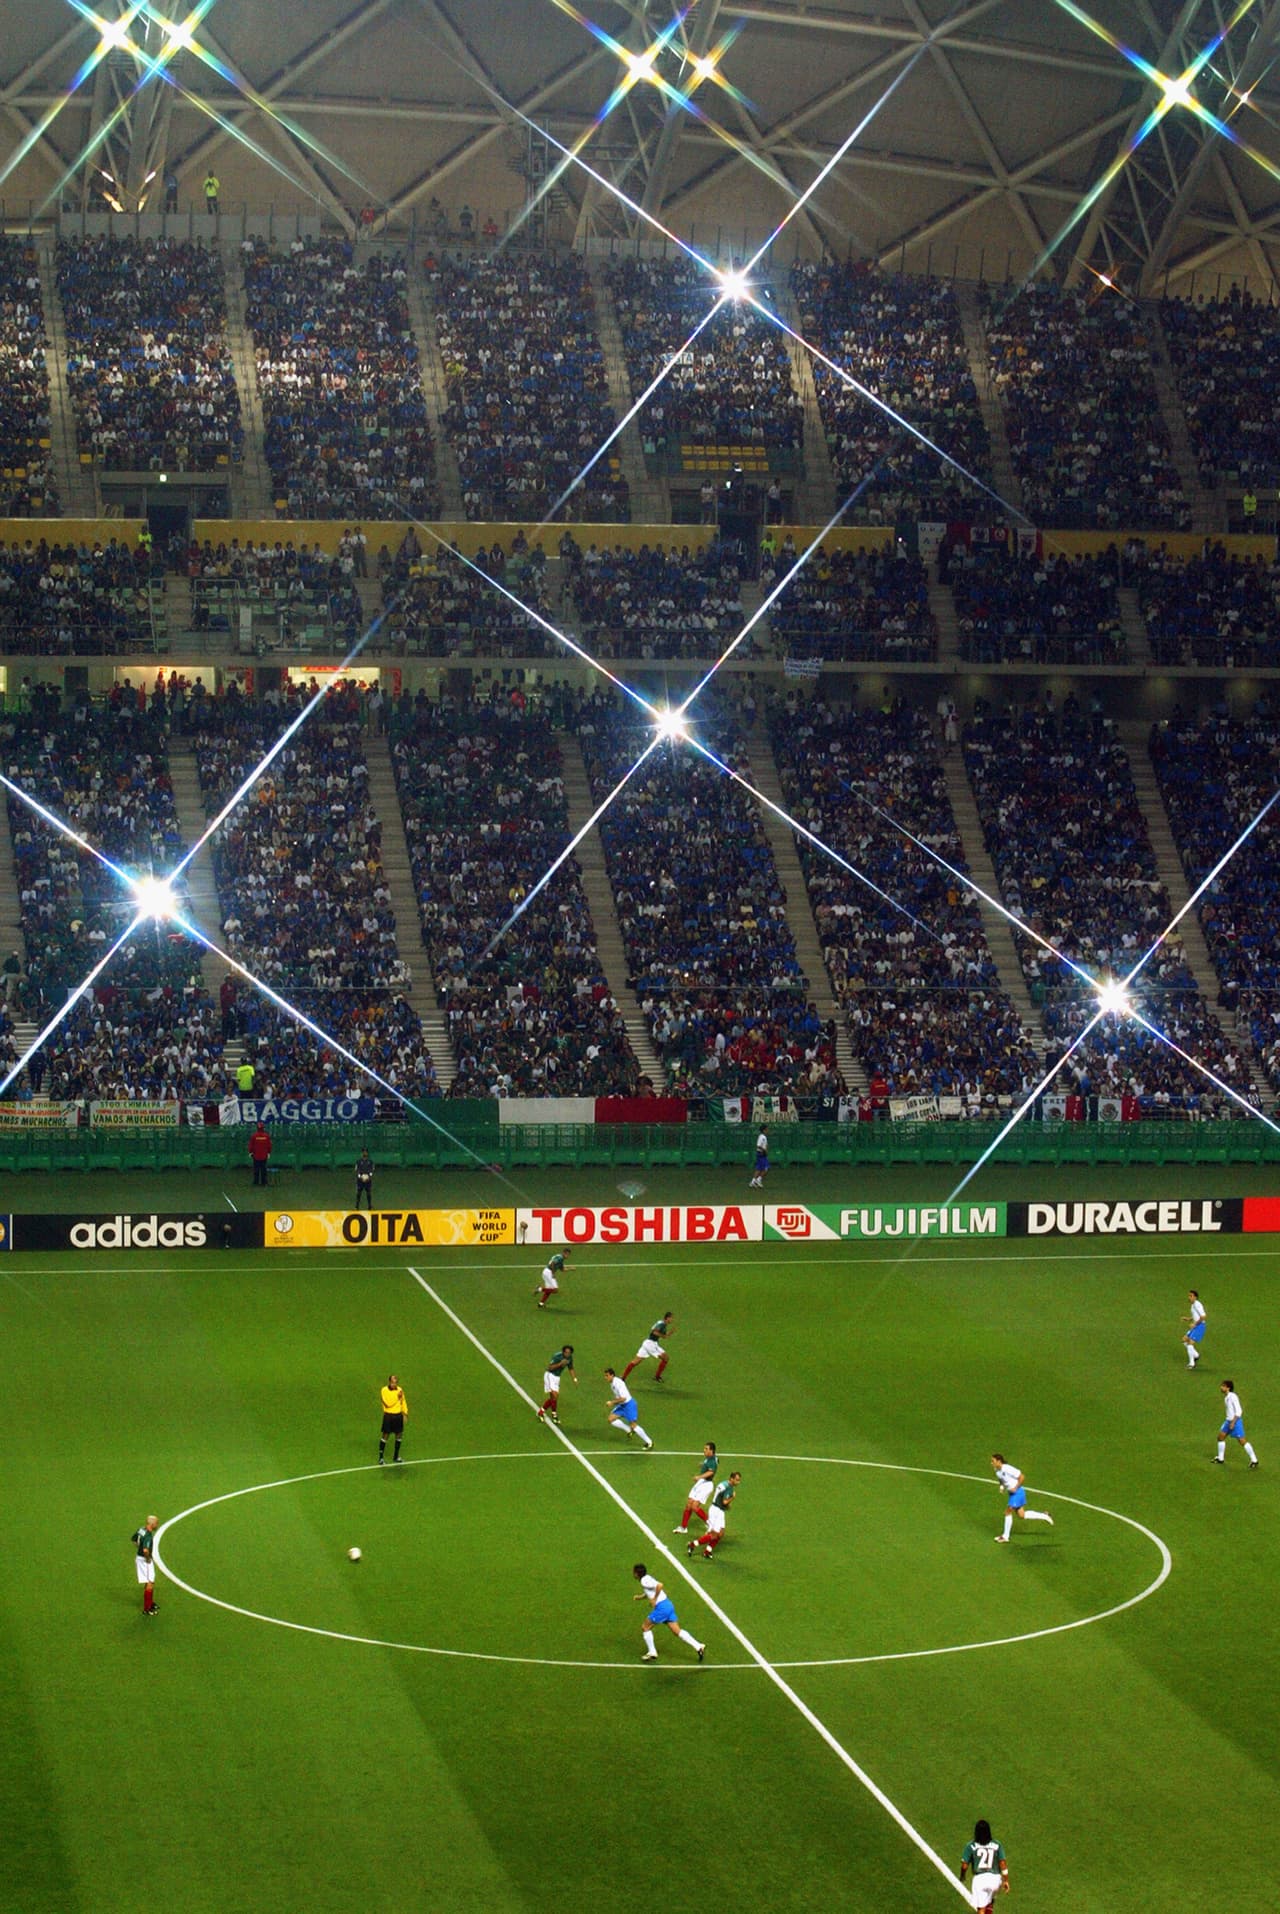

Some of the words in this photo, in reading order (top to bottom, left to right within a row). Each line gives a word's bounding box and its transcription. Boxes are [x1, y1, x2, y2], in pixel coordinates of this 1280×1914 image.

[93, 1113, 123, 1124] VAMOS
[126, 1114, 176, 1124] MUCHACHOS
[242, 1098, 358, 1122] BAGGIO
[342, 1213, 424, 1243] OITA
[472, 1222, 507, 1231] WORLD
[479, 1211, 501, 1220] FIFA
[532, 1207, 748, 1243] TOSHIBA
[840, 1205, 998, 1236] FUJIFILM
[1028, 1202, 1222, 1233] DURACELL
[70, 1215, 207, 1248] adidas
[976, 1848, 994, 1869] 21
